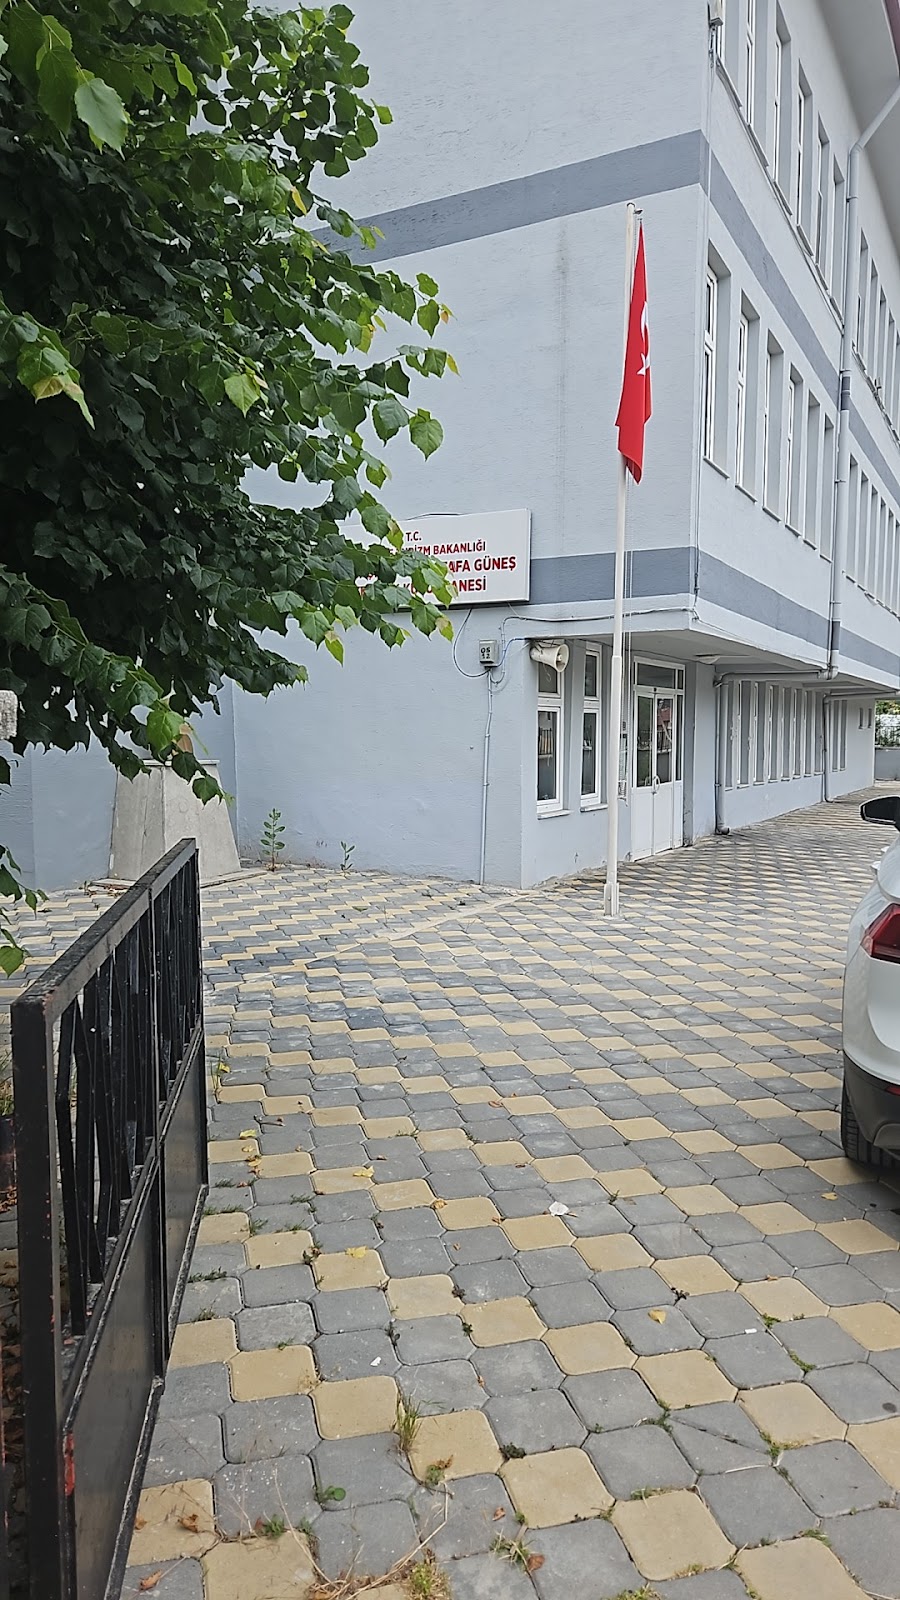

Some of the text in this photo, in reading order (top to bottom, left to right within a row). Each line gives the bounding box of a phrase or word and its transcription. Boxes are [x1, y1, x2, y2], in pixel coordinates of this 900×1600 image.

[405, 531, 422, 542] T.C.
[433, 539, 486, 555] BAKANLIĞI
[474, 555, 517, 572] GÜNEŞ
